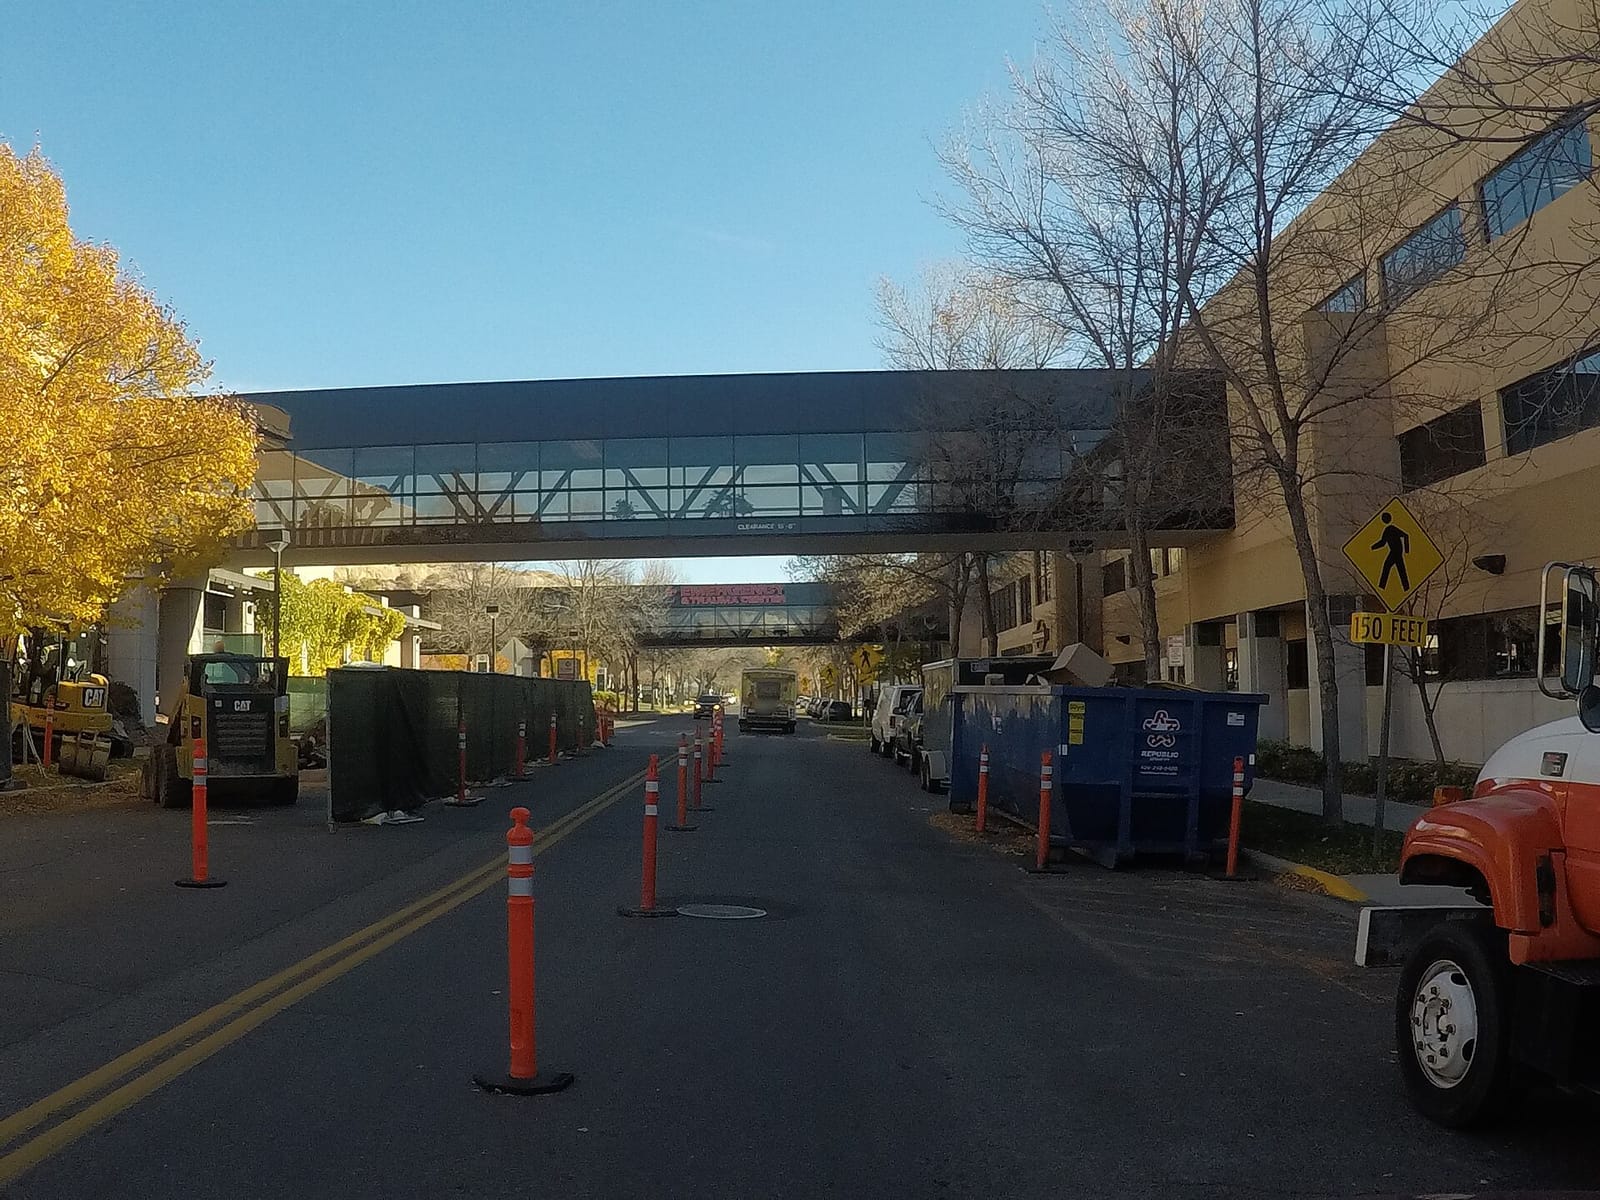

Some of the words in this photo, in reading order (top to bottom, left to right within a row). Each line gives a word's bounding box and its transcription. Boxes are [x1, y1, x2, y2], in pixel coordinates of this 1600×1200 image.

[1354, 616, 1382, 640] 150
[1391, 618, 1424, 643] FEET
[84, 688, 104, 707] CAT
[233, 700, 252, 712] CAT
[1140, 750, 1180, 759] REPUBLIC
